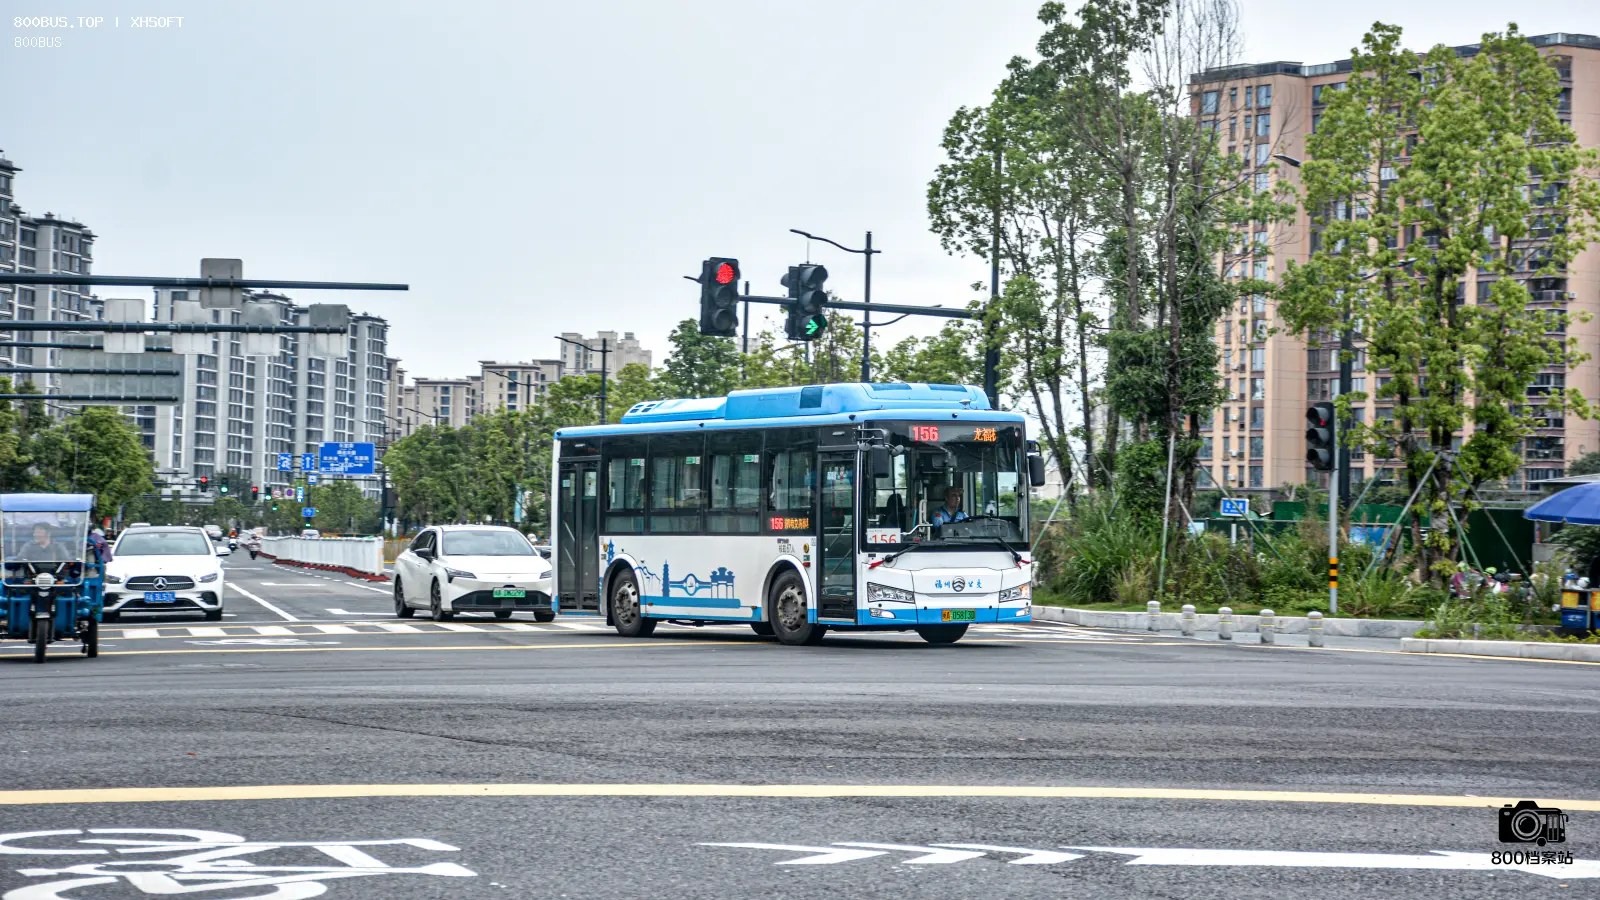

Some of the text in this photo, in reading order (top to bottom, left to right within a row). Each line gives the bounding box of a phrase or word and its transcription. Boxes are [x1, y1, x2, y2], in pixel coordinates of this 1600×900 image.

[912, 426, 939, 442] 156
[771, 517, 784, 530] 156
[871, 534, 897, 544] 156
